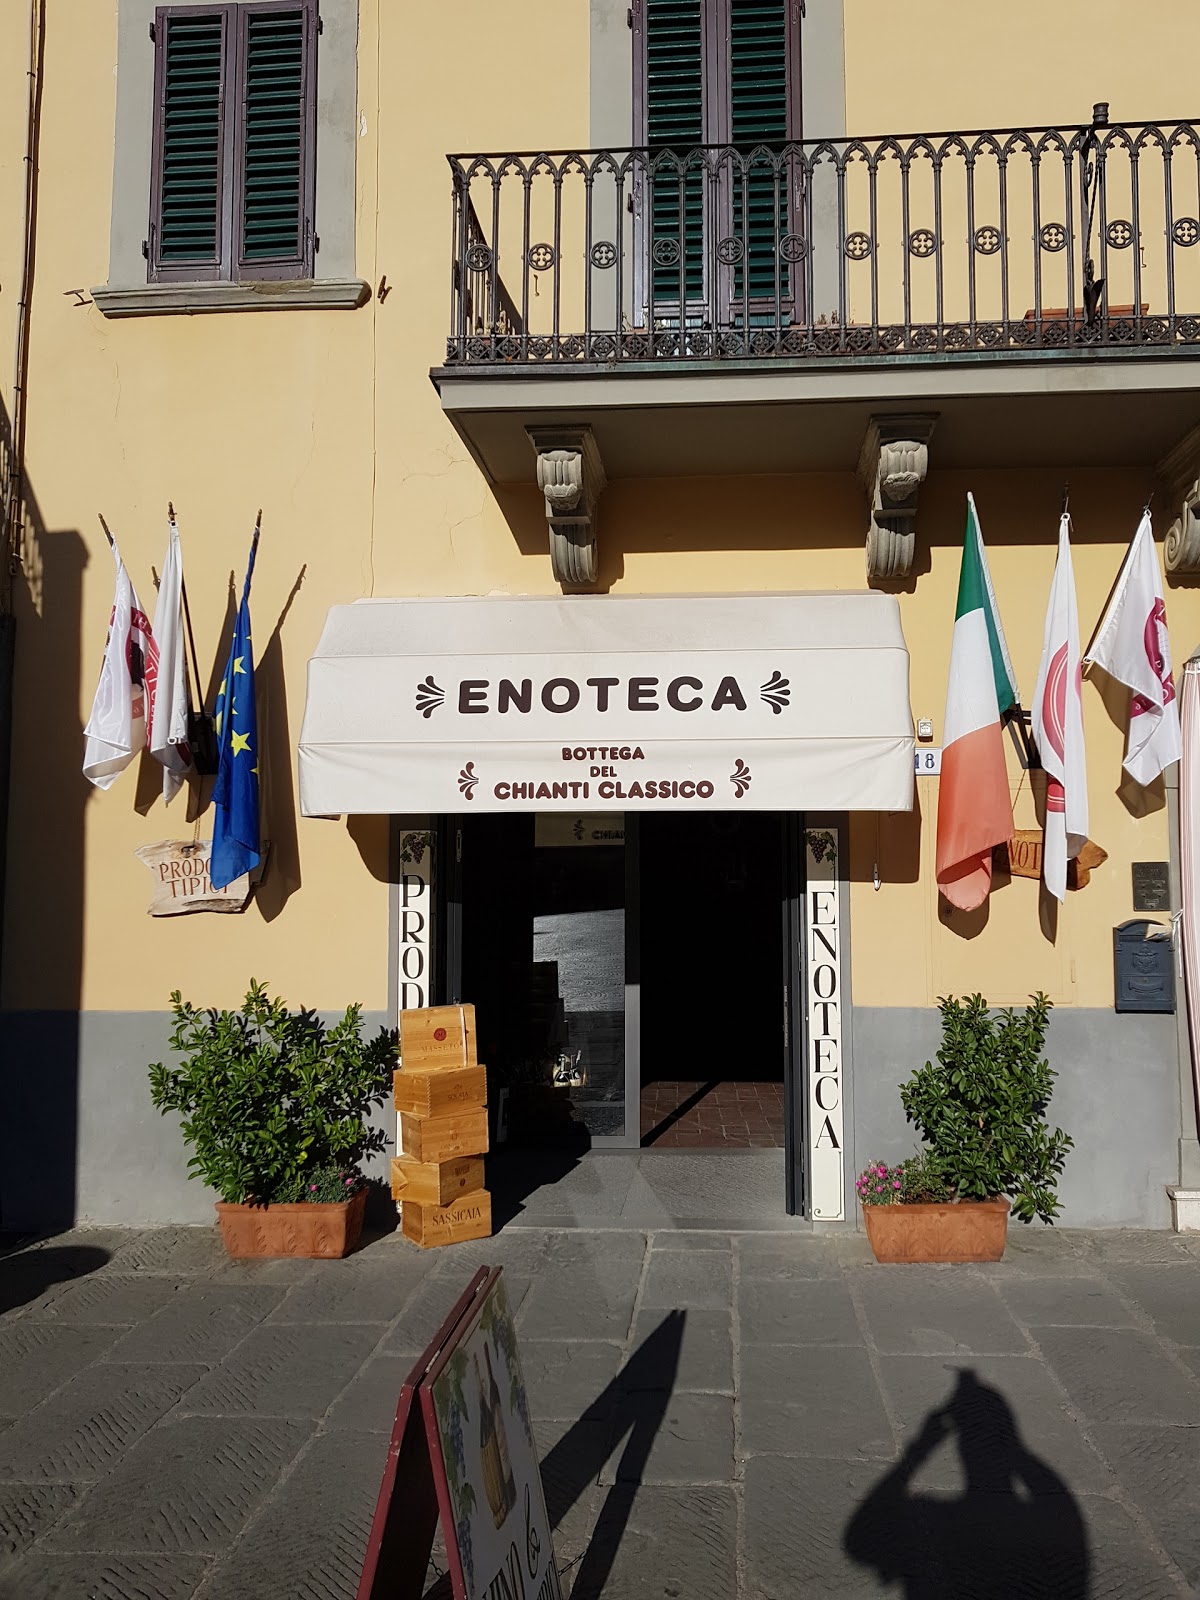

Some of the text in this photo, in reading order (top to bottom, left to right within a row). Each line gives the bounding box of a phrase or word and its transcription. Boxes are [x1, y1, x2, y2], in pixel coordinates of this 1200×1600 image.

[458, 675, 748, 714] ENOTECA
[562, 746, 645, 761] BOTTEGA
[915, 753, 936, 769] 18
[590, 766, 618, 778] DEL
[494, 781, 714, 800] CHIANTI CLASSICO
[811, 890, 840, 1149] ENOTECA
[432, 1206, 482, 1227] SASSICAIA
